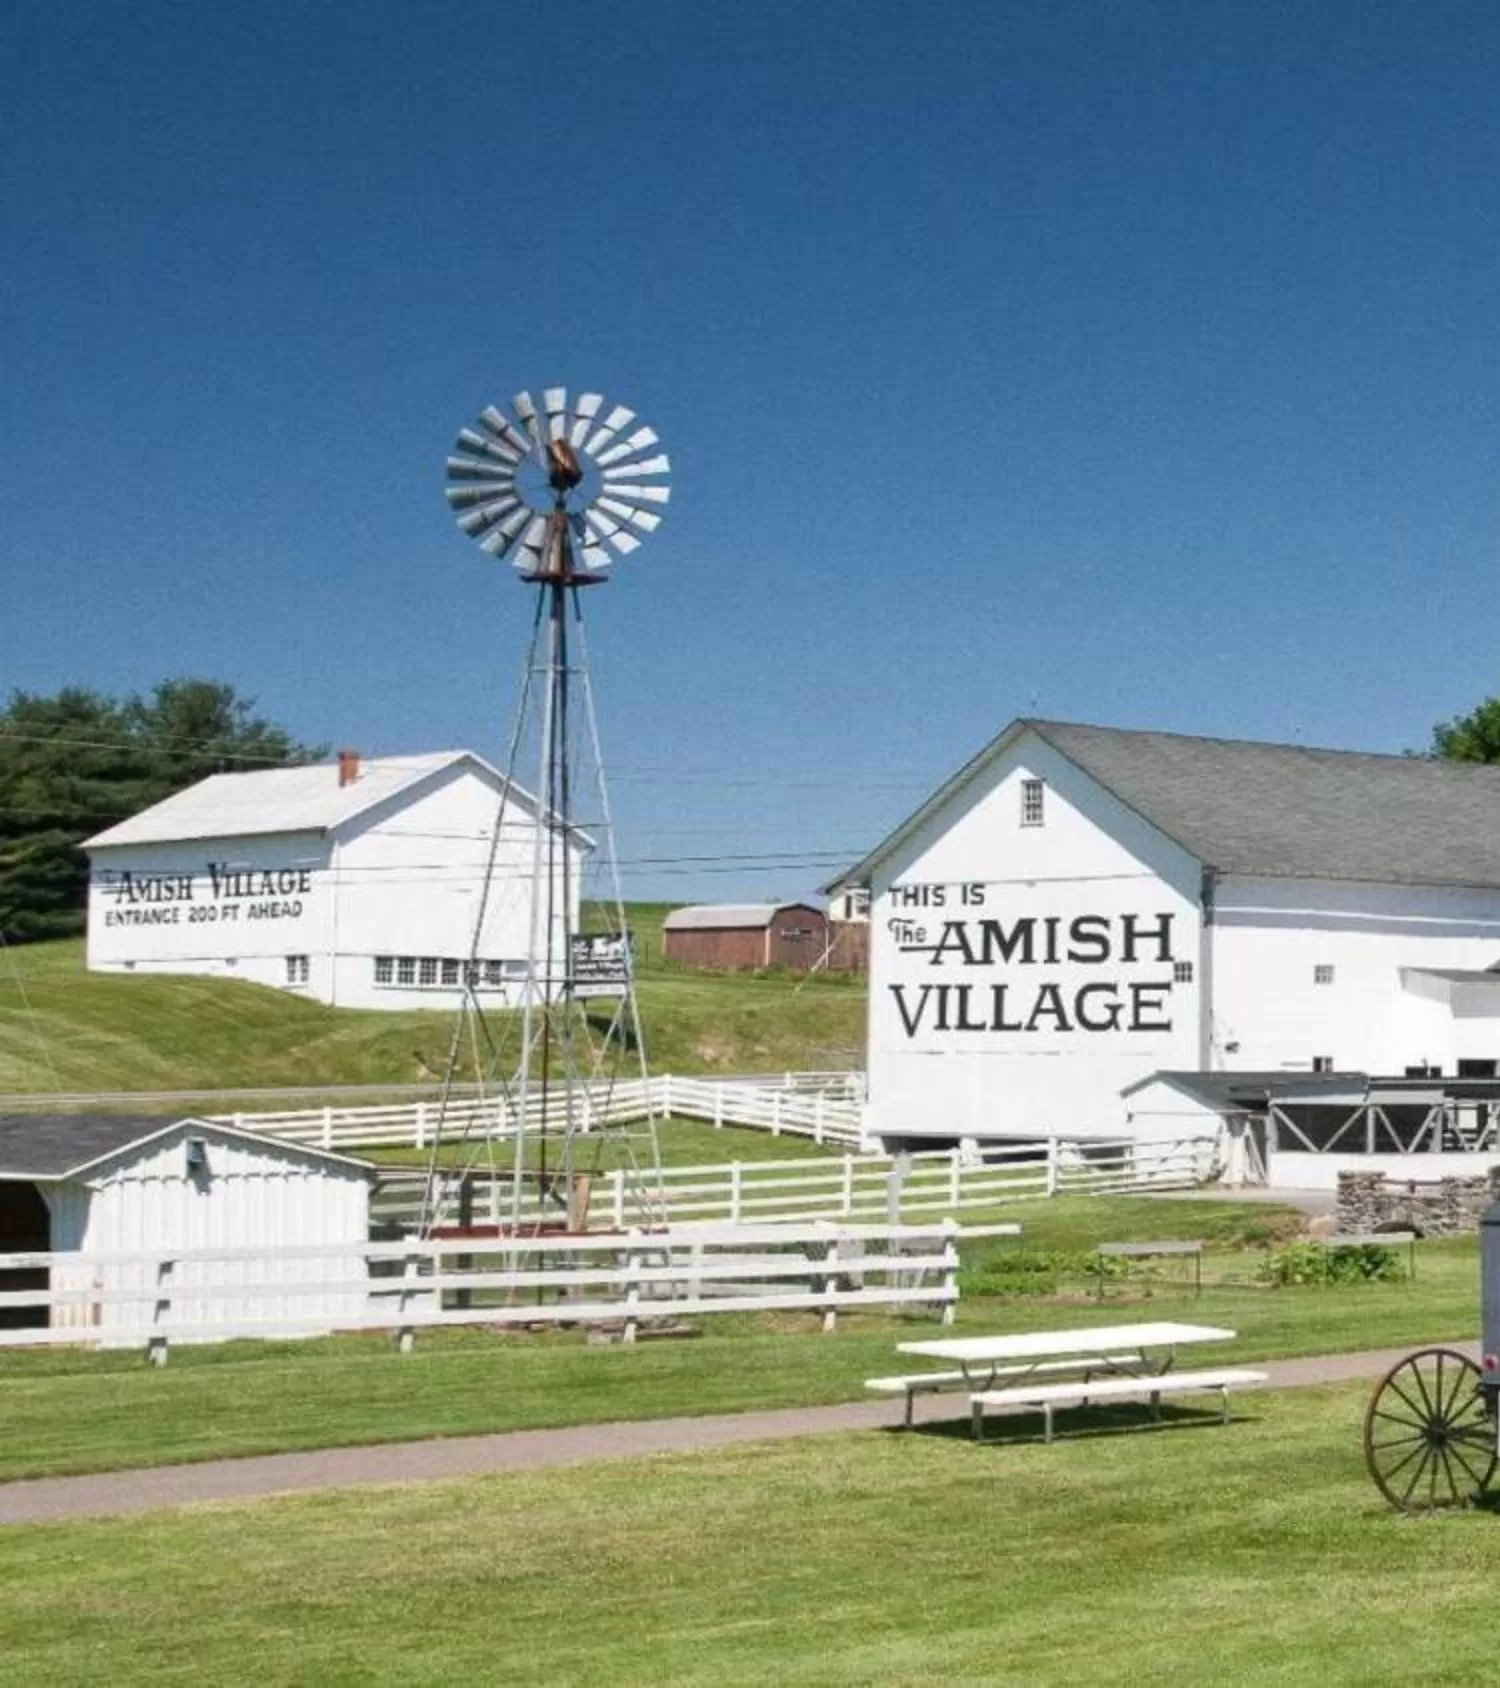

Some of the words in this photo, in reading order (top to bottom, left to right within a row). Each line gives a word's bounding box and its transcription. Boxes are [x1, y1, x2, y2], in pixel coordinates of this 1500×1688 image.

[114, 870, 194, 904] AMISH
[207, 862, 312, 899] VILLAGE
[888, 884, 945, 907] THIS
[961, 883, 986, 905] IS
[104, 907, 180, 927] ENTRANCE
[187, 904, 217, 923] 200
[222, 903, 240, 921] FT
[247, 900, 303, 919] AHEAD
[887, 917, 928, 944] The
[899, 913, 1176, 966] AMISH
[888, 981, 1173, 1038] VILLAGE
